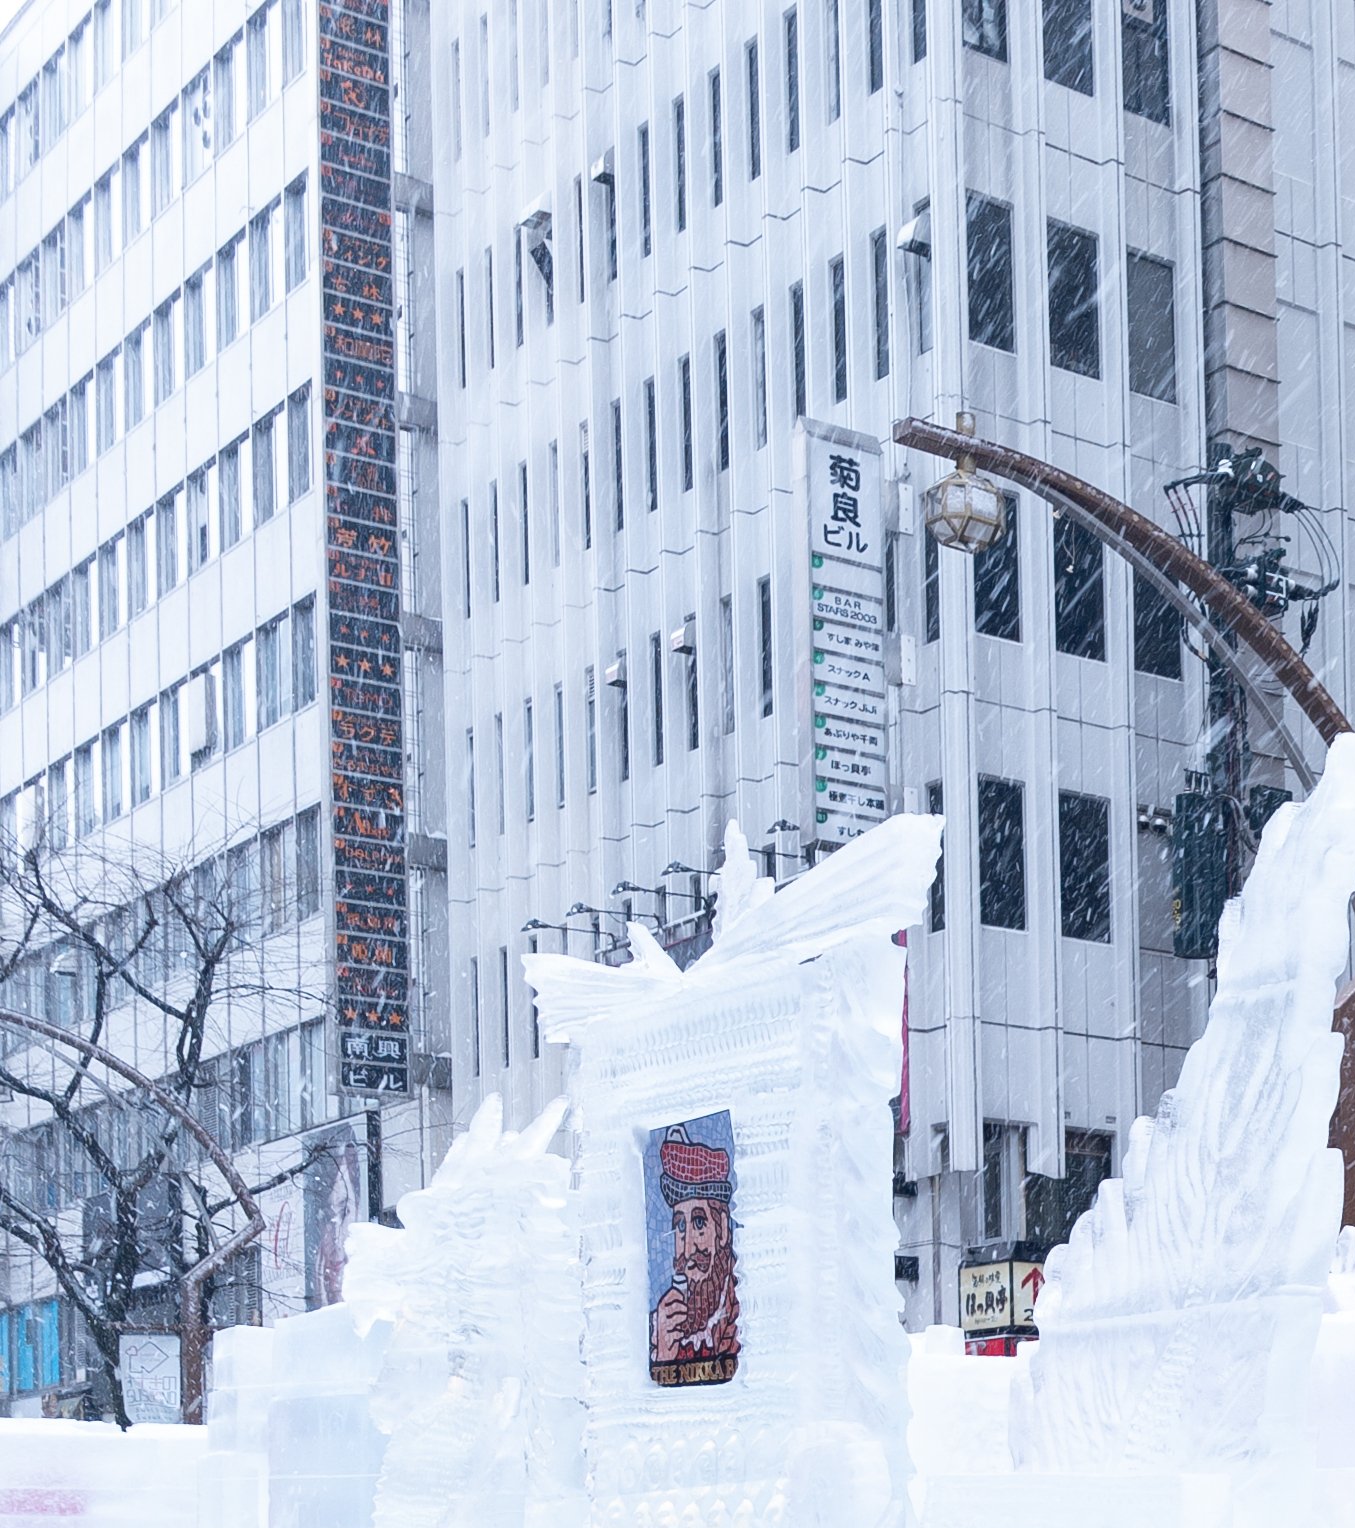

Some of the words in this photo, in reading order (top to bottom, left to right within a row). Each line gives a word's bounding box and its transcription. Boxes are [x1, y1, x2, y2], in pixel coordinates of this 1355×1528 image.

[834, 596, 862, 610] BAR
[850, 610, 878, 625] 2003
[827, 664, 861, 680] スナック
[824, 695, 858, 710] スナック
[651, 1364, 677, 1386] THE
[678, 1363, 726, 1384] NIKKA
